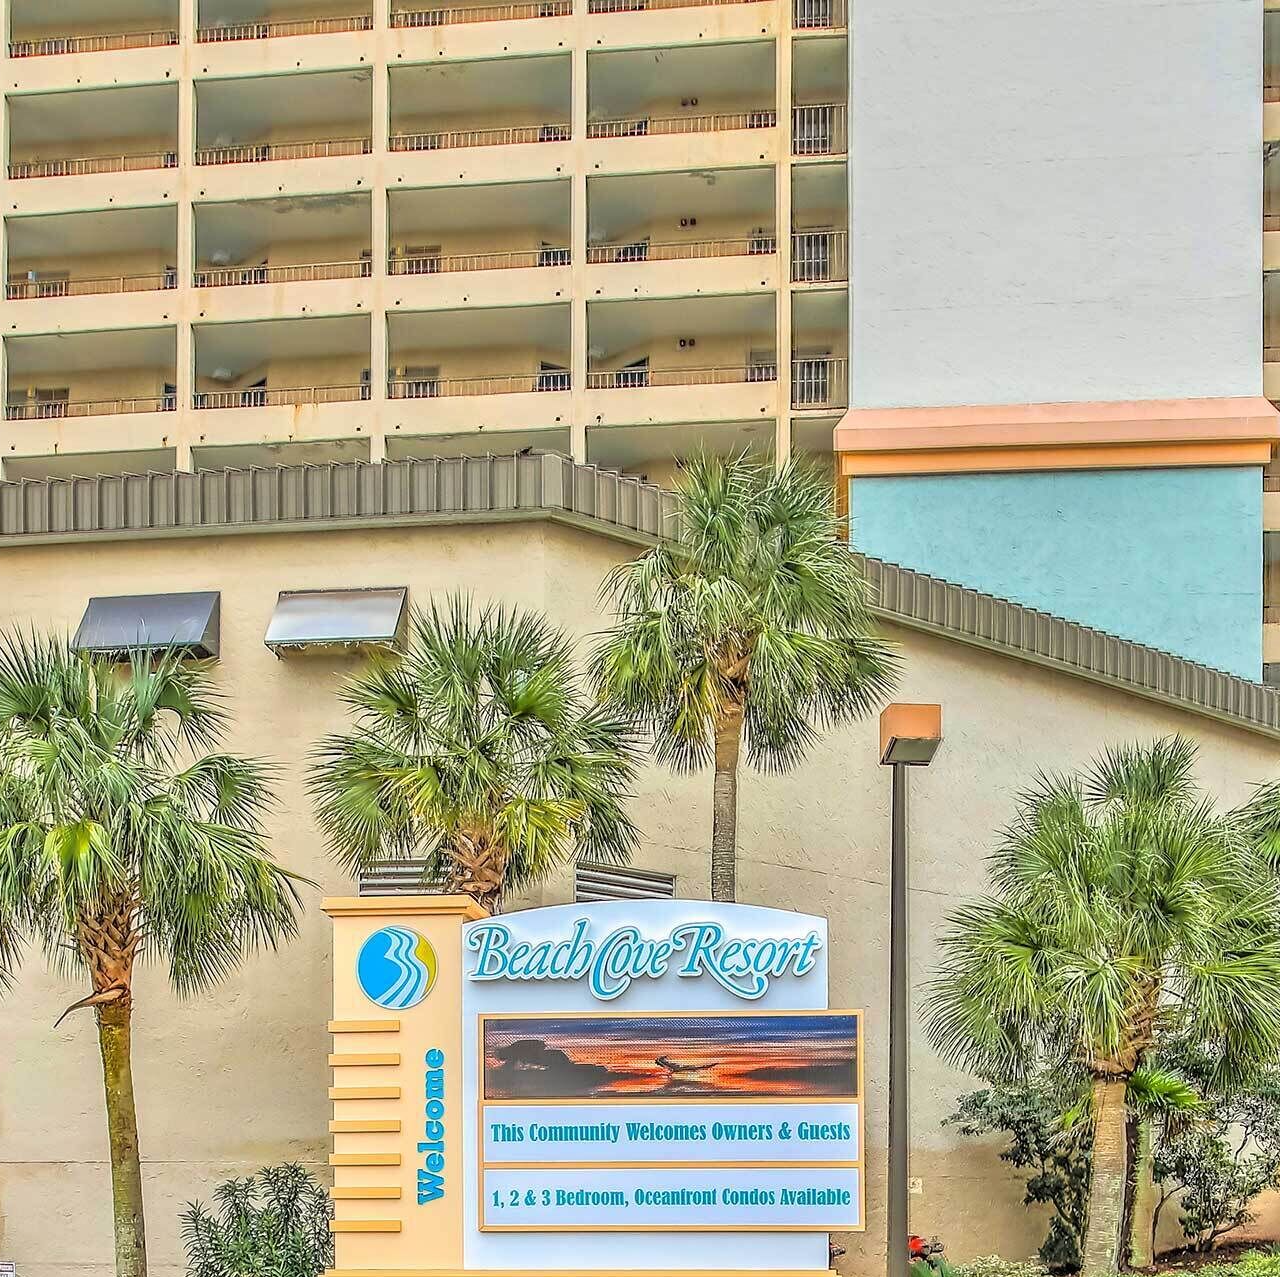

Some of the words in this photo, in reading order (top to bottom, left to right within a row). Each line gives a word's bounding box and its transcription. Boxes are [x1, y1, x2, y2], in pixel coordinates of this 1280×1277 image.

[468, 919, 592, 978] Beach
[590, 927, 671, 998] Cove
[671, 923, 820, 1000] Resort
[416, 1048, 445, 1206] Welcome
[490, 1123, 524, 1142] This
[528, 1122, 620, 1144] Community
[625, 1122, 707, 1142] Welcomes
[711, 1121, 773, 1141] Owners
[777, 1121, 792, 1141] &
[797, 1121, 851, 1141] Guests
[492, 1189, 505, 1209] 1,
[509, 1189, 520, 1207] 2
[523, 1189, 537, 1207] &
[541, 1189, 551, 1206] 3
[555, 1188, 629, 1208] Bedroom,
[633, 1188, 718, 1206] Oceanfront
[722, 1188, 776, 1206] Condos
[779, 1188, 851, 1206] Available
